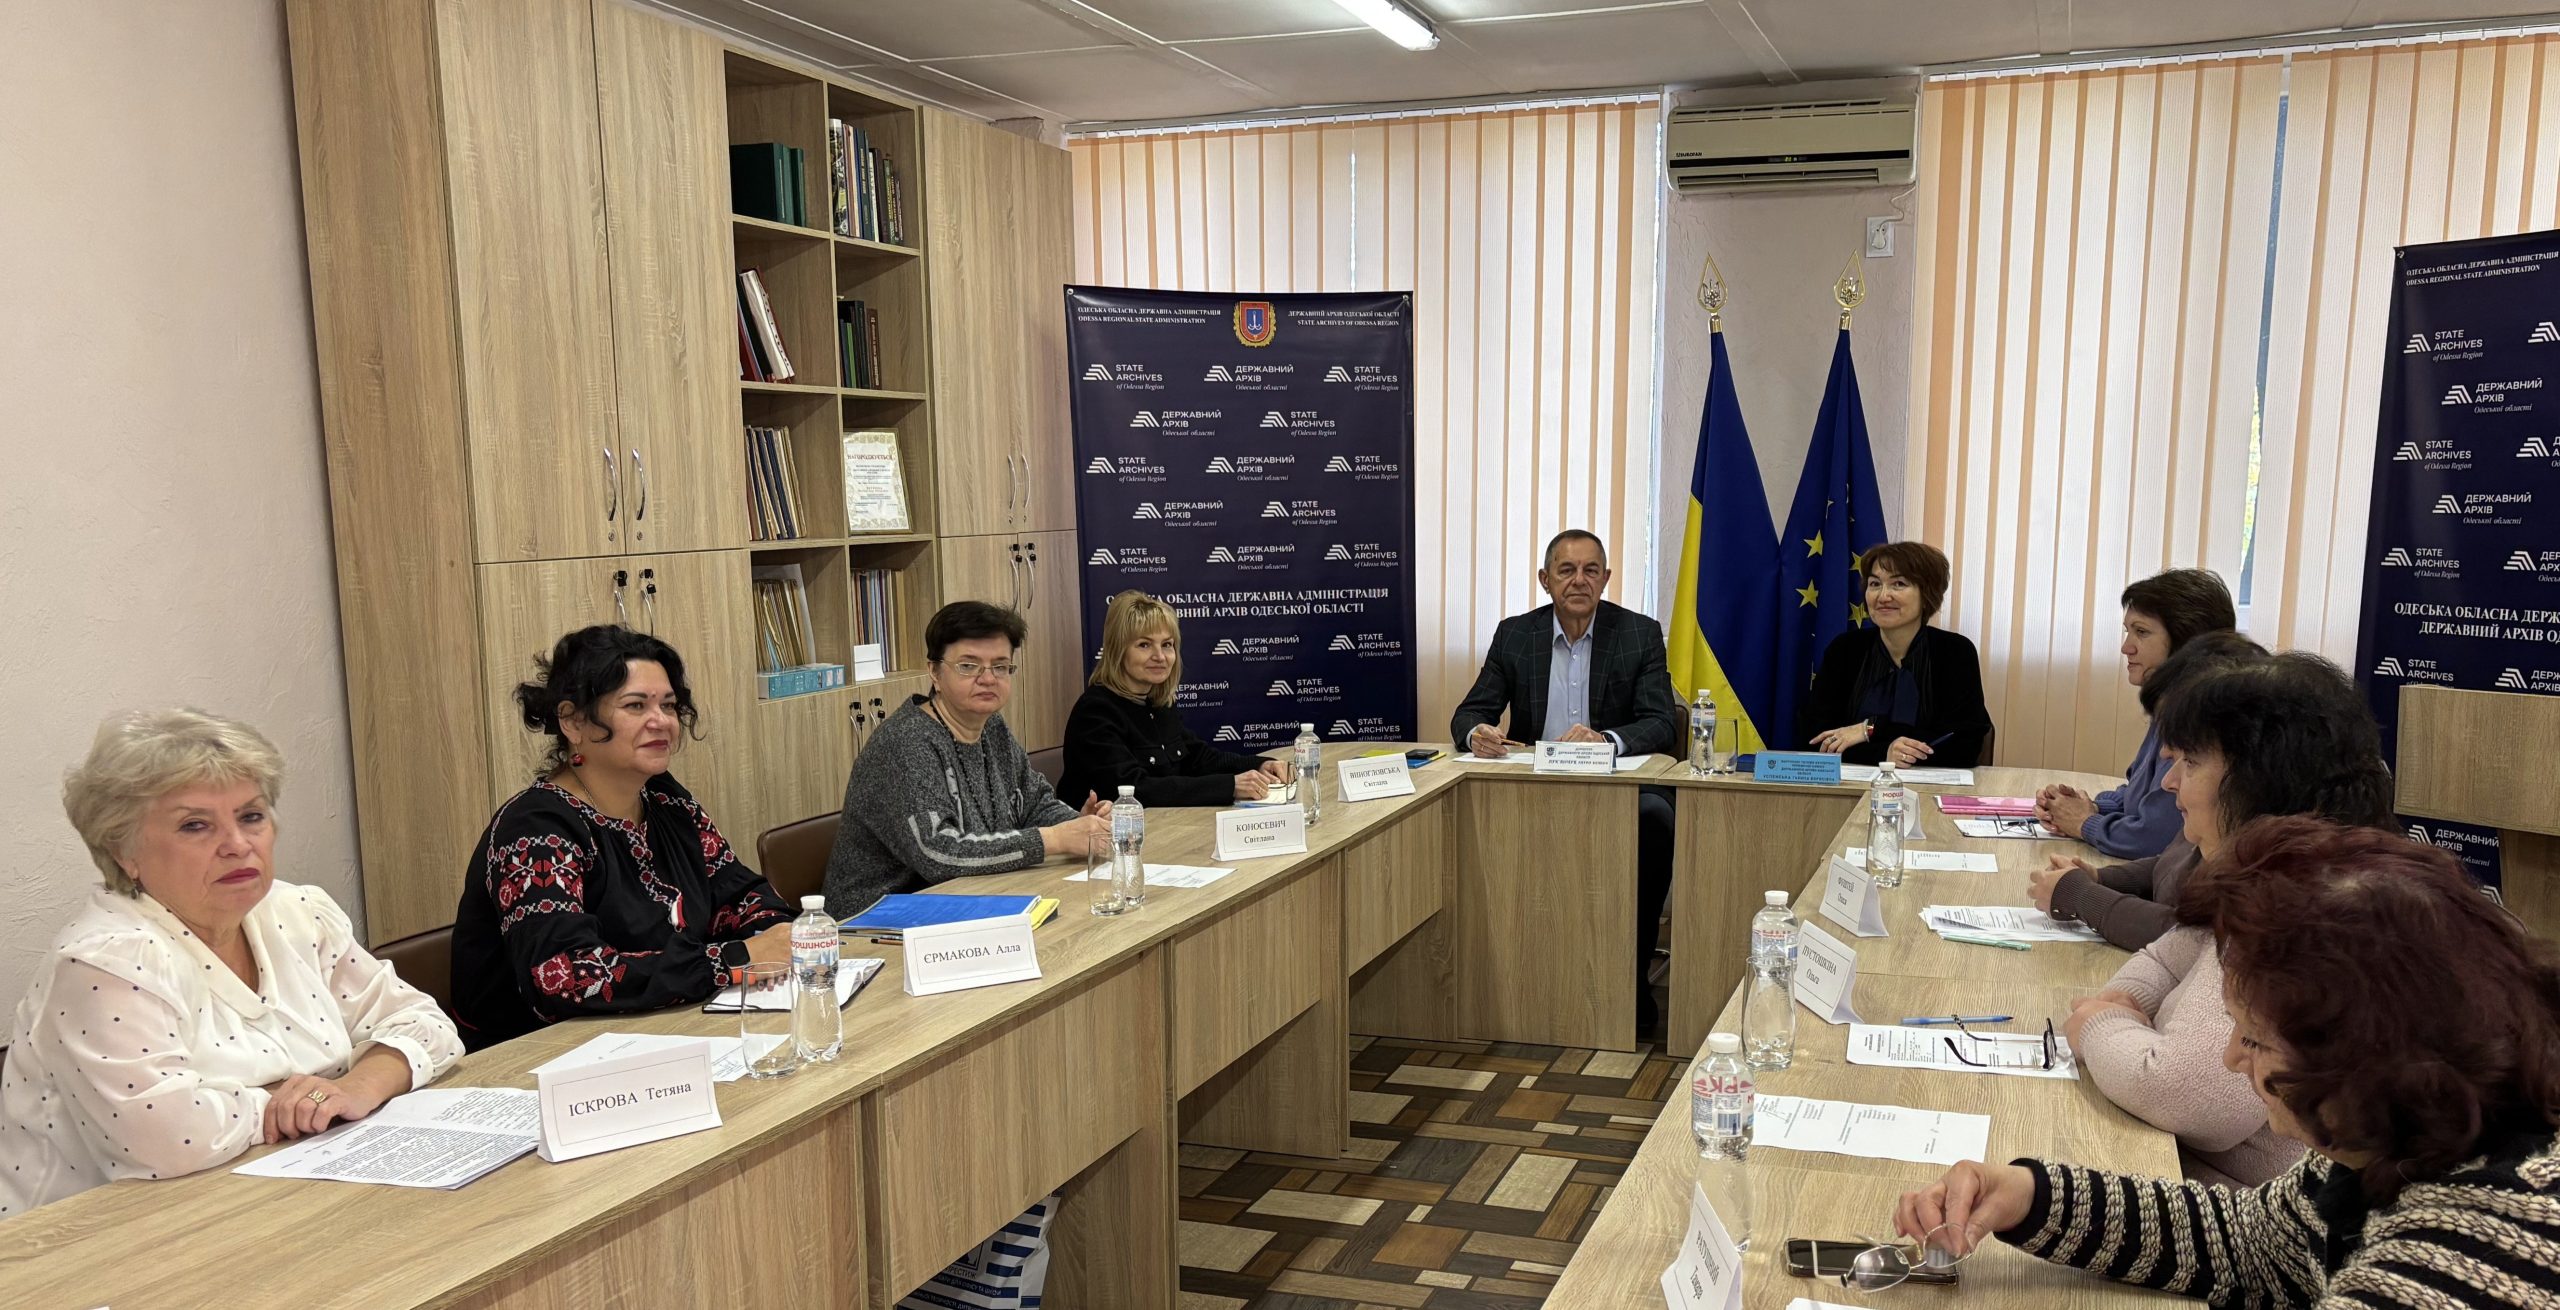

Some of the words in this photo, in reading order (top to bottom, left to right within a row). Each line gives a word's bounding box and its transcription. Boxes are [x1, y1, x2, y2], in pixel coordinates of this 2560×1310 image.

[2407, 267, 2435, 277] ОДЕСЬКА
[2436, 263, 2467, 273] ОБЛАСНА
[2468, 259, 2504, 269] ДЕРЖАВНА
[2406, 278, 2429, 286] ODESSA
[2429, 274, 2463, 283] REGIONAL
[2463, 271, 2483, 279] STATE
[2483, 264, 2540, 277] ADMINISTRATION
[2435, 330, 2464, 340] STATE
[2434, 339, 2483, 350] ARCHIVES
[2440, 352, 2461, 360] Odessa
[2462, 351, 2483, 360] Region
[1115, 364, 1144, 372] STATE
[1235, 364, 1294, 374] ДЕРЖАВНИЙ
[1354, 366, 1381, 374] STATE
[1116, 373, 1163, 381] ARCHIVES
[1354, 375, 1398, 383] ARCHIVES
[1382, 384, 1399, 392] Region
[2475, 378, 2543, 393] ДЕРЖАВНИЙ
[2475, 393, 2504, 403] АРХІВ
[1161, 410, 1221, 419] ДЕРЖАВНИЙ
[1290, 411, 1317, 419] STATE
[1162, 420, 1189, 428] АРХІВ
[1291, 420, 1335, 428] ARCHIVES
[1319, 429, 1337, 437] Region
[2425, 441, 2453, 449] STATE
[1355, 455, 1380, 463] STATE
[2425, 450, 2472, 459] ARCHIVES
[1118, 457, 1146, 465] STATE
[1236, 455, 1295, 464] ДЕРЖАВНИЙ
[1119, 466, 1165, 474] ARCHIVES
[1237, 465, 1263, 473] АРХІВ
[1355, 464, 1398, 472] ARCHIVES
[2430, 462, 2450, 470] Odessa
[2451, 462, 2472, 470] Region
[1149, 476, 1167, 484] Region
[2464, 492, 2532, 504] ДЕРЖАВНИЙ
[1164, 501, 1224, 510] ДЕРЖАВНИЙ
[2464, 505, 2493, 514] АРХІВ
[1164, 511, 1191, 519] АРХІВ
[1292, 509, 1336, 517] ARCHIVES
[1320, 518, 1338, 526] Region
[1120, 548, 1148, 556] STATE
[1237, 544, 1295, 554] ДЕРЖАВНИЙ
[2416, 548, 2443, 557] STATE
[1120, 556, 1166, 565] ARCHIVES
[1237, 554, 1264, 562] АРХІВ
[1354, 552, 1397, 560] ARCHIVES
[2415, 559, 2460, 569] ARCHIVES
[2539, 563, 2560, 572] АРХ
[2441, 571, 2460, 579] Region
[1166, 593, 1224, 604] ОБЛАСНА
[1227, 591, 1293, 603] ДЕРЖАВНА
[1296, 588, 1389, 601] АДМІНІСТРАЦІЯ
[1213, 606, 1248, 617] АРХІВ
[1250, 602, 1311, 616] ОДЕСЬКОЇ
[1313, 603, 1364, 614] ОБЛАСТІ
[2394, 602, 2452, 617] ОДЕСЬКА
[2455, 606, 2518, 622] ОБЛАСНА
[2521, 610, 2560, 624] ДЕРЖ
[2419, 621, 2499, 639] ДЕРЖАВНИЙ
[2503, 628, 2543, 641] АРХІВ
[1242, 635, 1300, 646] ДЕРЖАВНИЙ
[1357, 633, 1383, 641] STATE
[1243, 645, 1268, 654] АРХІВ
[1358, 641, 1401, 650] ARCHIVES
[2408, 659, 2437, 669] STATE
[2407, 670, 2454, 681] ARCHIVES
[1296, 678, 1323, 686] STATE
[1297, 686, 1340, 695] ARCHIVES
[1357, 717, 1383, 725] STATE
[1243, 721, 1300, 732] ДЕРЖАВНИЙ
[1358, 725, 1400, 734] ARCHIVES
[1244, 731, 1269, 740] АРХІВ
[1236, 819, 1286, 832] КОНОСЕВИЧ
[1244, 835, 1275, 844] Світлана
[2435, 829, 2499, 847] ДЕРЖАВНИЙ
[2435, 839, 2463, 851] АРХІВ
[923, 945, 990, 965] ЄРМАКОВА
[996, 942, 1021, 955] Алла
[568, 1091, 639, 1117] ІСКРОВА
[644, 1080, 692, 1100] Тетяна
